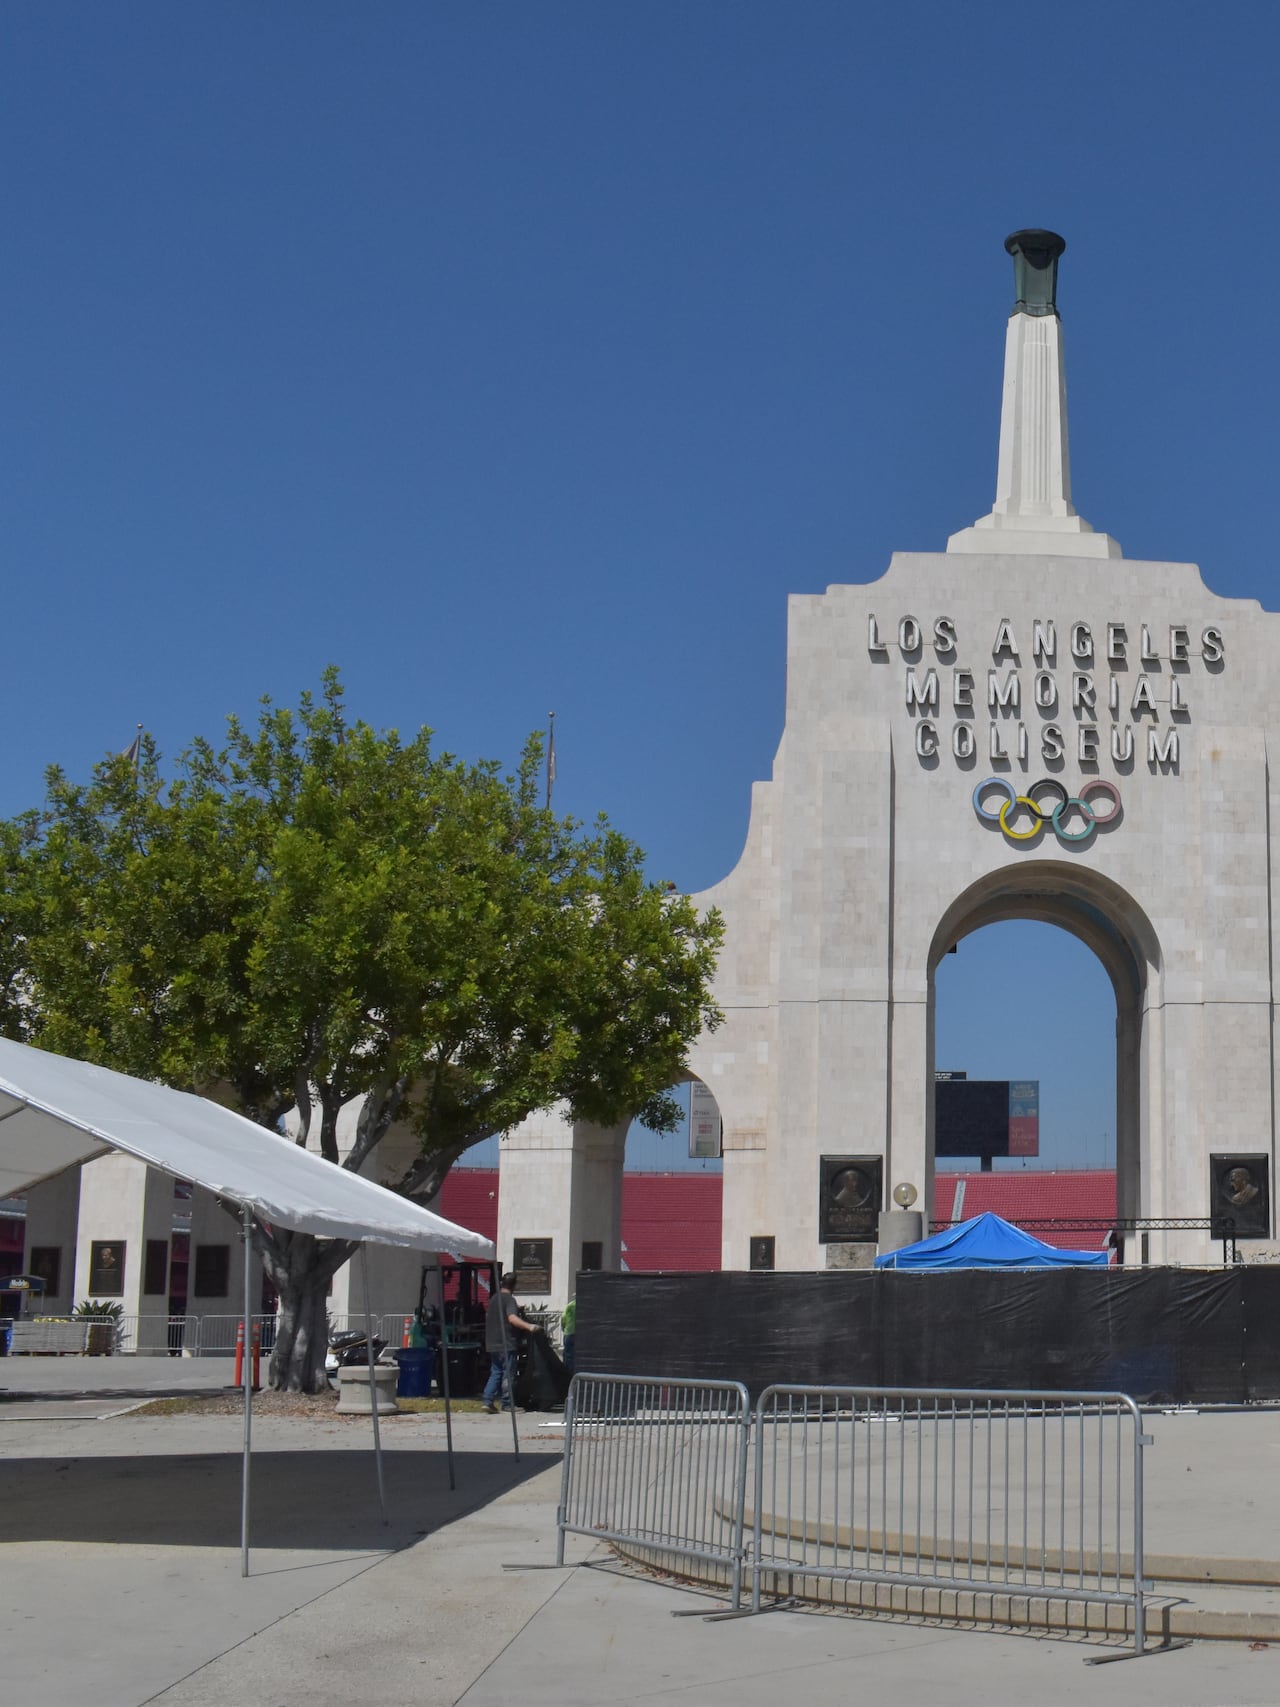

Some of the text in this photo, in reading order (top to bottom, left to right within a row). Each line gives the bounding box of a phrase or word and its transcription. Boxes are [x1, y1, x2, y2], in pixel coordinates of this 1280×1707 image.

[868, 613, 1223, 663] LOS ANGELES
[906, 667, 1189, 712] MEMORIAL
[915, 719, 1179, 763] COLISEUM
